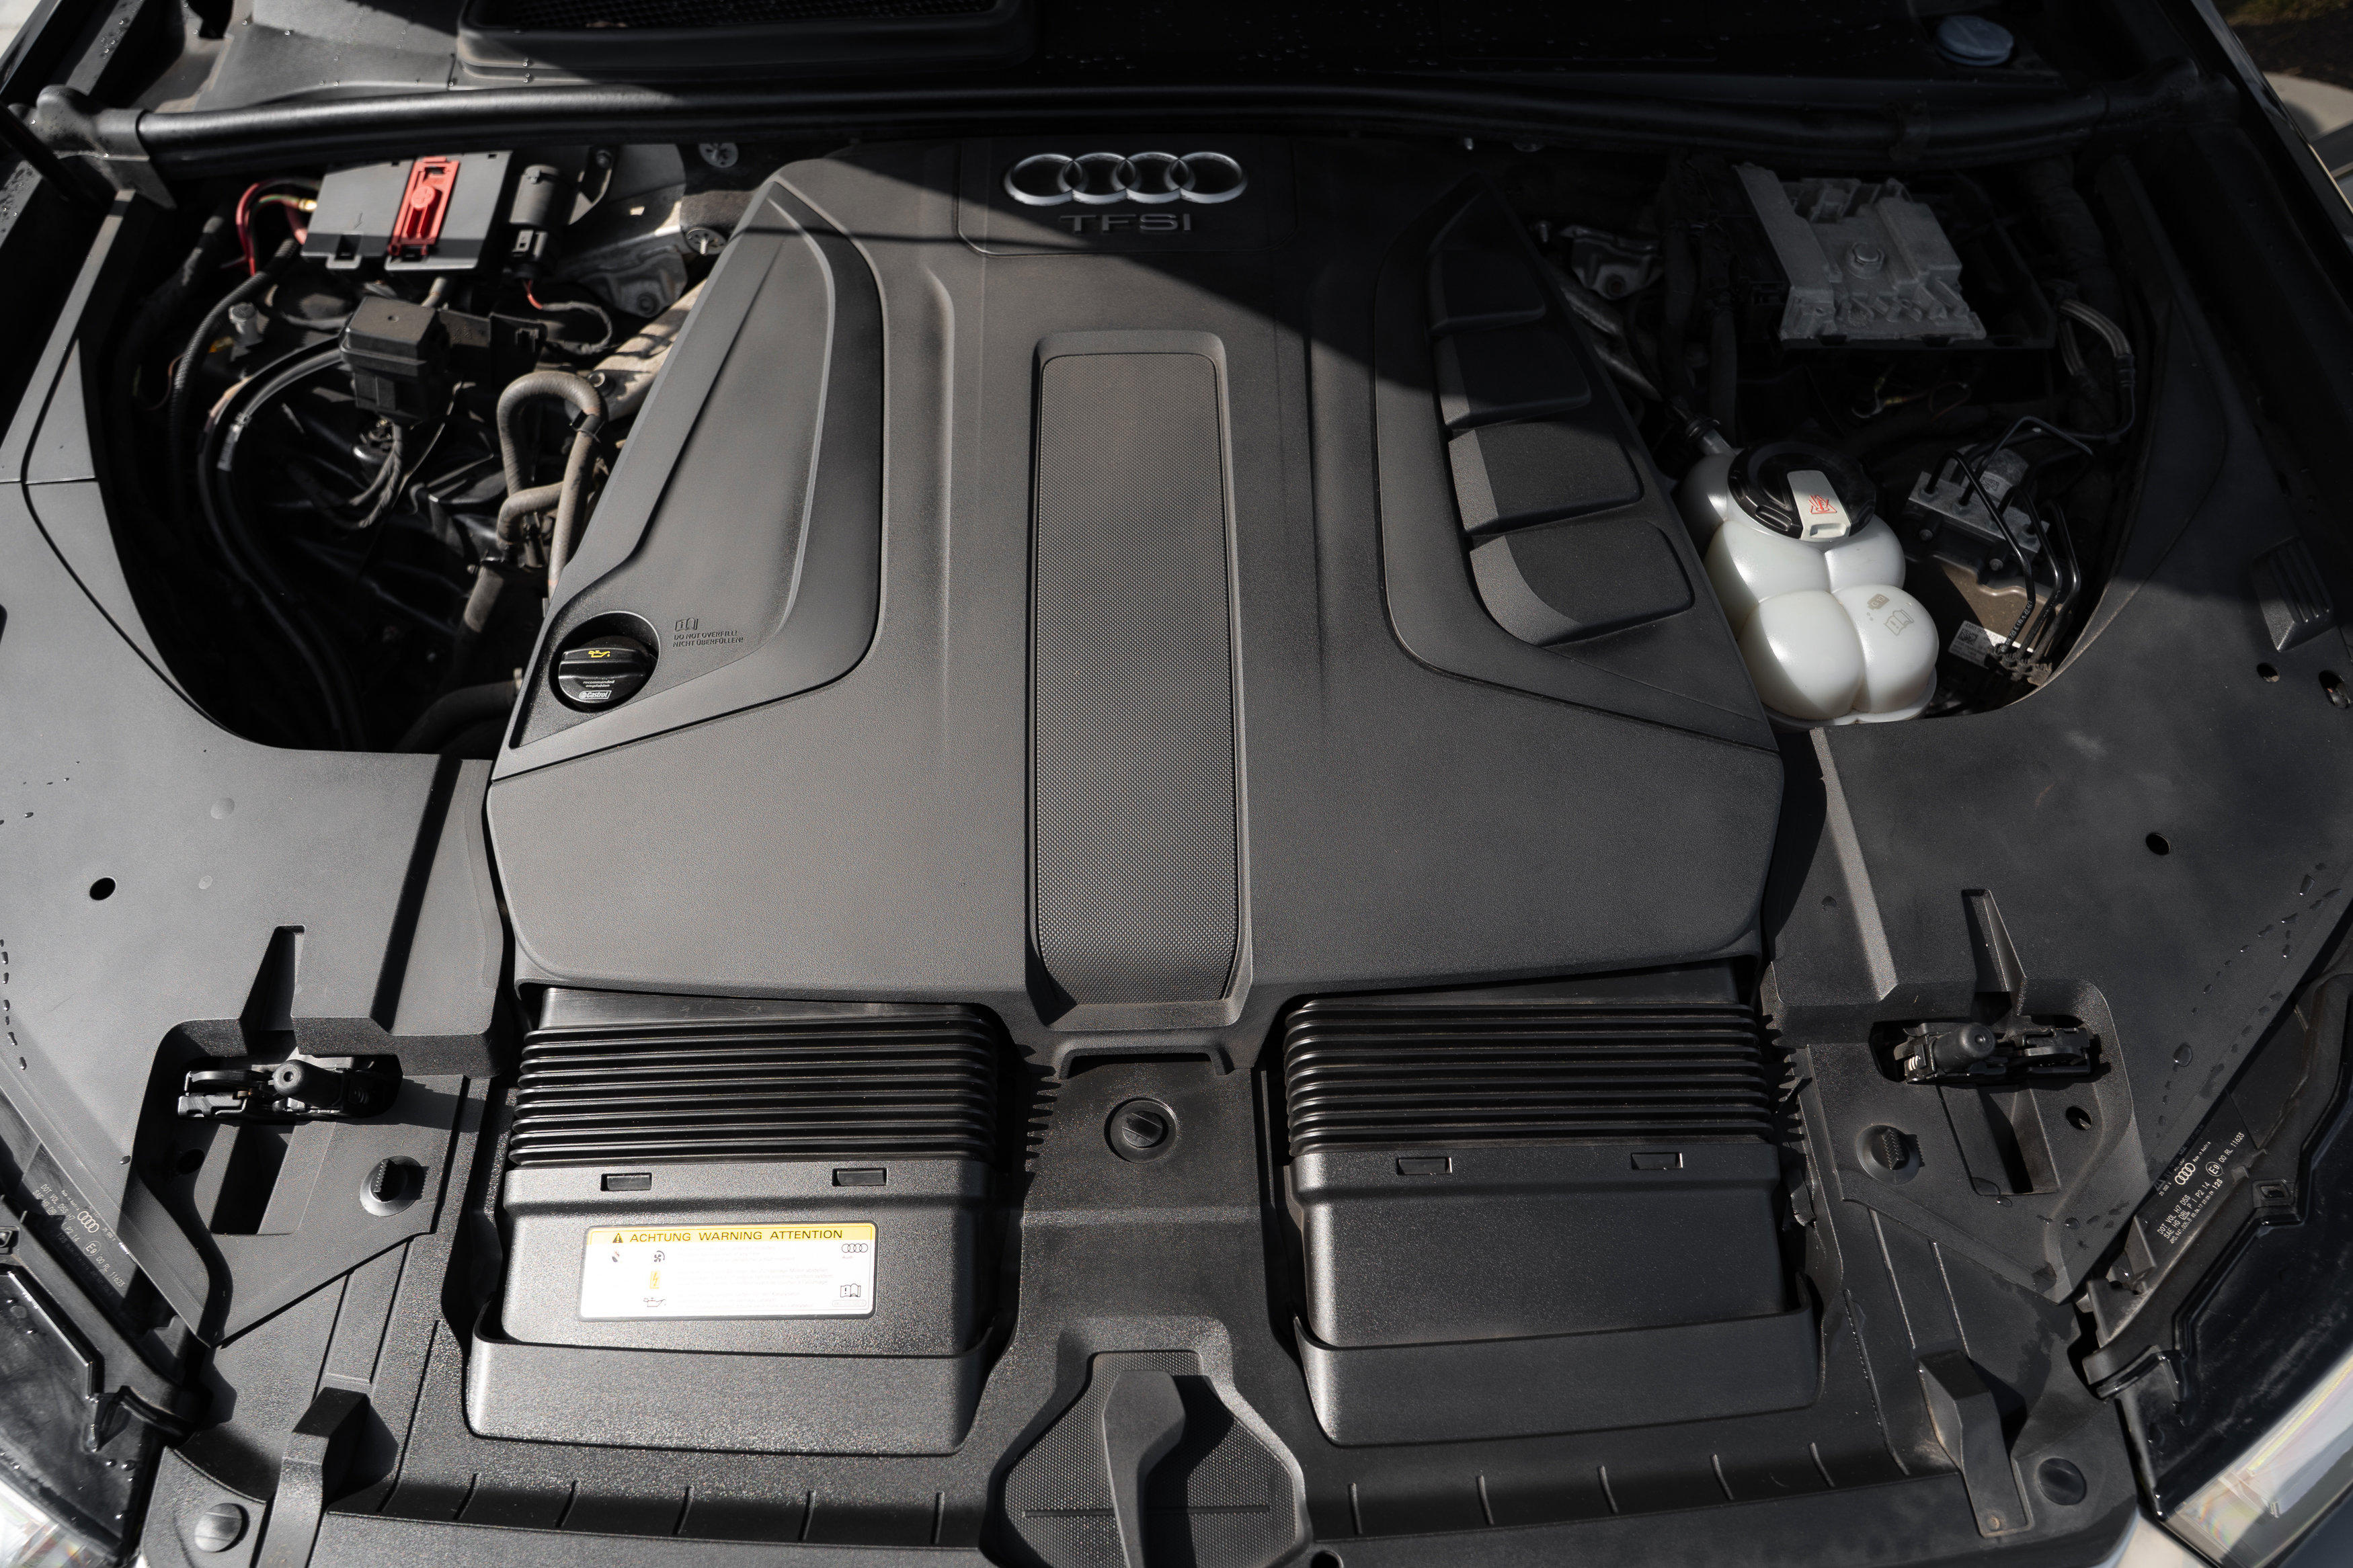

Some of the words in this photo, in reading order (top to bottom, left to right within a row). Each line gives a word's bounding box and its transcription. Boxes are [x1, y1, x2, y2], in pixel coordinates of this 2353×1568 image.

[1060, 214, 1191, 231] TFSI
[696, 637, 744, 645] ÜBERFÜLLEN!
[2231, 1132, 2244, 1147] 11623
[2212, 1178, 2223, 1190] 12S
[40, 1184, 52, 1194] DOT
[50, 1194, 59, 1204] VOL
[58, 1204, 69, 1214] D5S
[32, 1190, 44, 1200] SAE
[42, 1199, 50, 1207] HG
[65, 1226, 74, 1234] P2
[2157, 1223, 2167, 1234] DOT
[2165, 1214, 2176, 1223] VOL
[2174, 1205, 2182, 1213] H7
[2180, 1195, 2190, 1206] D5S
[2163, 1228, 2174, 1239] SAE
[2172, 1220, 2180, 1228] HG
[2178, 1210, 2190, 1221] DRL
[2195, 1190, 2204, 1198] P2
[629, 1232, 691, 1243] ACHTUNG
[699, 1231, 762, 1241] WARNING
[770, 1229, 843, 1239] ATTENTION
[103, 1263, 110, 1272] RL
[110, 1272, 125, 1287] 11623
